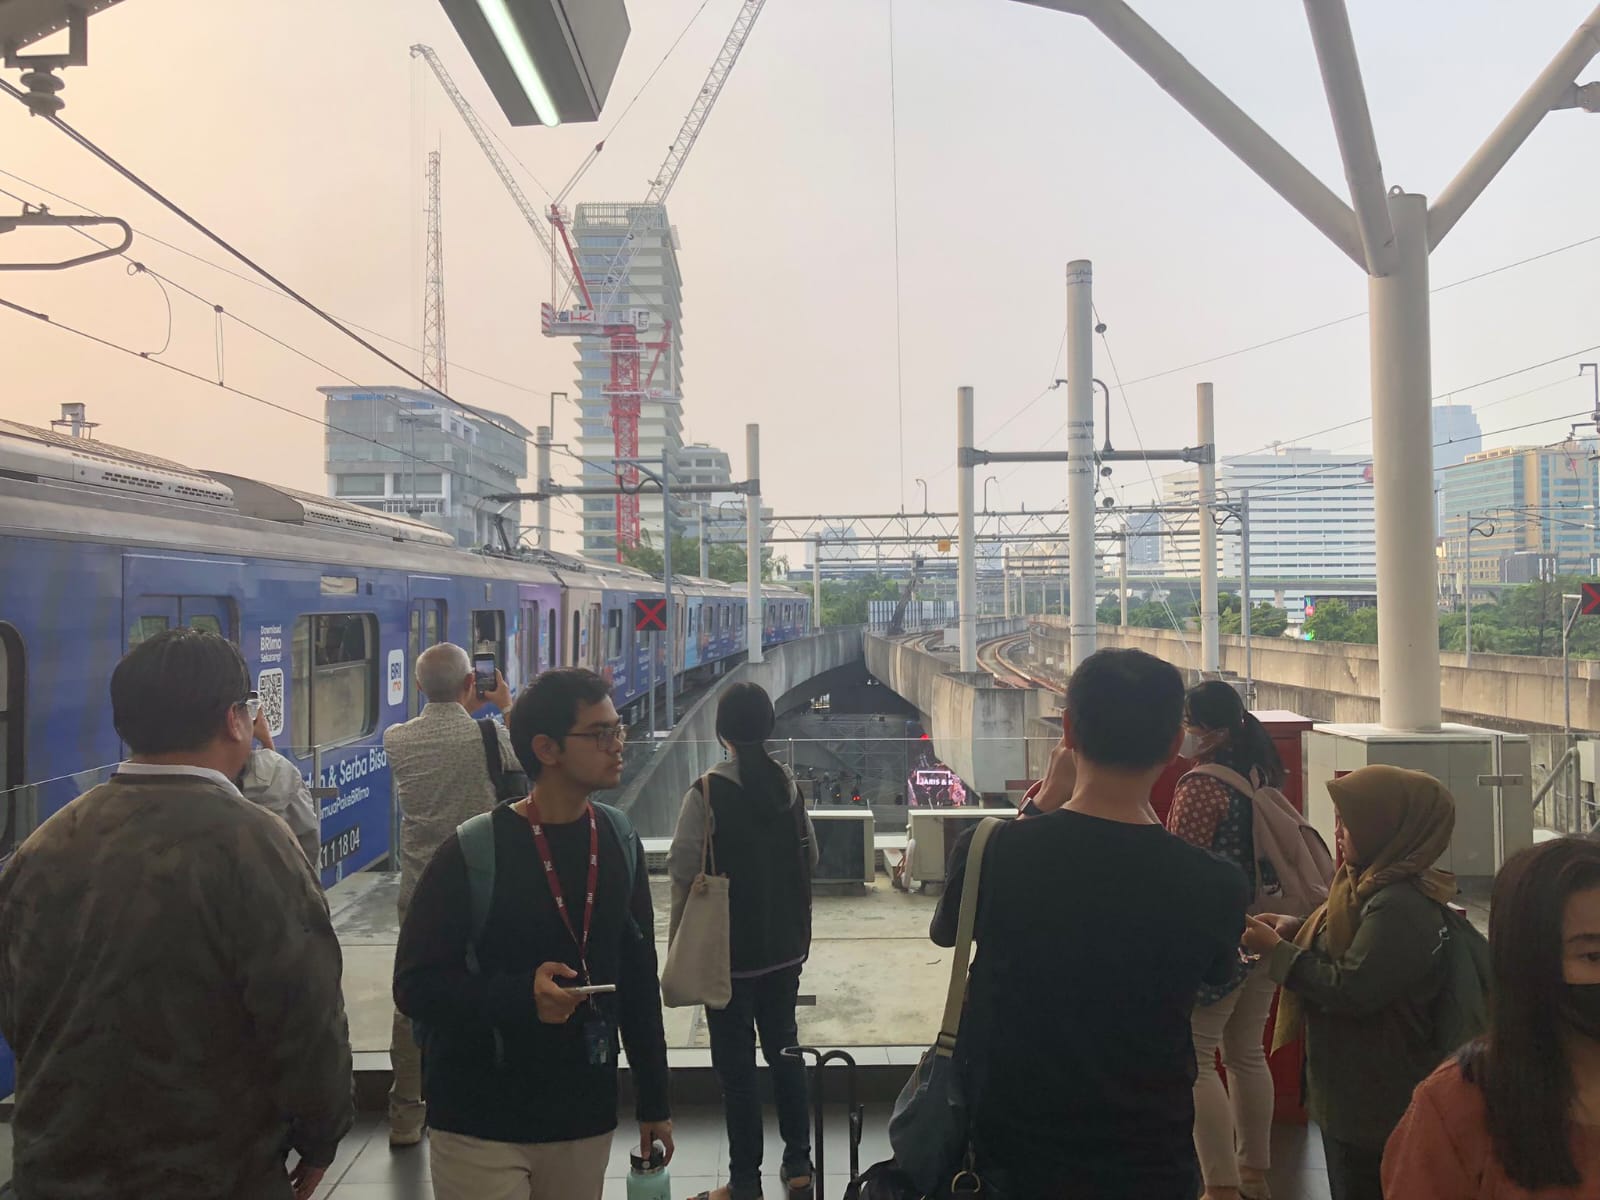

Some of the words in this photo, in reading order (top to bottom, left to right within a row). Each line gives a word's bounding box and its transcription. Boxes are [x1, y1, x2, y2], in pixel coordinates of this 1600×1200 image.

[391, 662, 402, 680] BRI
[339, 754, 368, 786] Serba
[369, 747, 387, 773] Bisa
[338, 835, 349, 858] 18
[350, 827, 361, 851] 04
